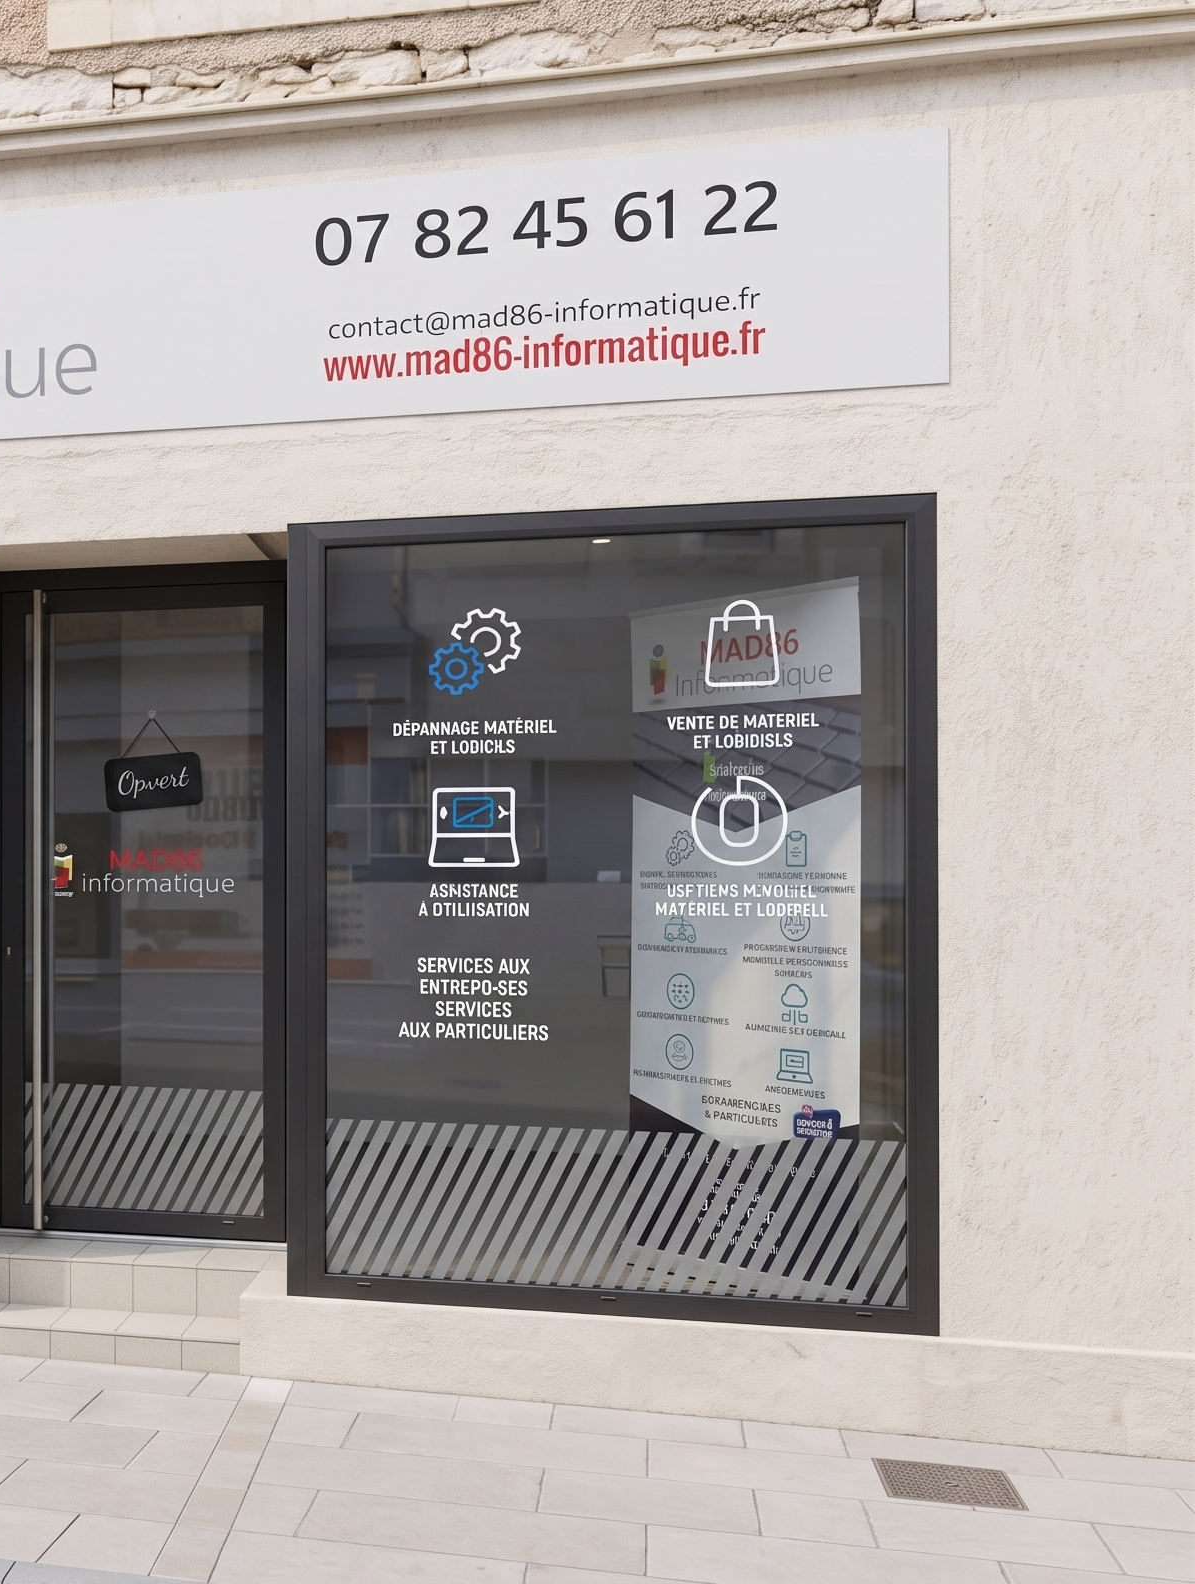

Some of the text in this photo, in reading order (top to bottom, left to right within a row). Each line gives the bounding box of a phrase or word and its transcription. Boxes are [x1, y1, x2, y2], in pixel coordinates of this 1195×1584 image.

[315, 180, 779, 267] 07 82 45 61 22
[328, 287, 761, 340] contact@mad86-informatique.fr
[323, 320, 766, 382] www.mad86-informatique.fr
[700, 629, 799, 666] MAD86
[484, 717, 557, 735] MATÉRIEL
[667, 713, 820, 731] VENTE DE MATERIEL
[430, 740, 448, 755] ET
[693, 735, 710, 749] ET
[109, 848, 204, 872] MAD86
[82, 873, 235, 898] informatique
[655, 901, 729, 917] MATÉRIEL
[735, 903, 752, 917] ET
[417, 957, 530, 975] SERVICES AUX
[420, 979, 528, 997] ENTREPO-SES
[435, 1000, 512, 1018] SERVICES
[399, 1022, 549, 1041] AUX PARTICULIERS
[704, 1110, 711, 1119] &
